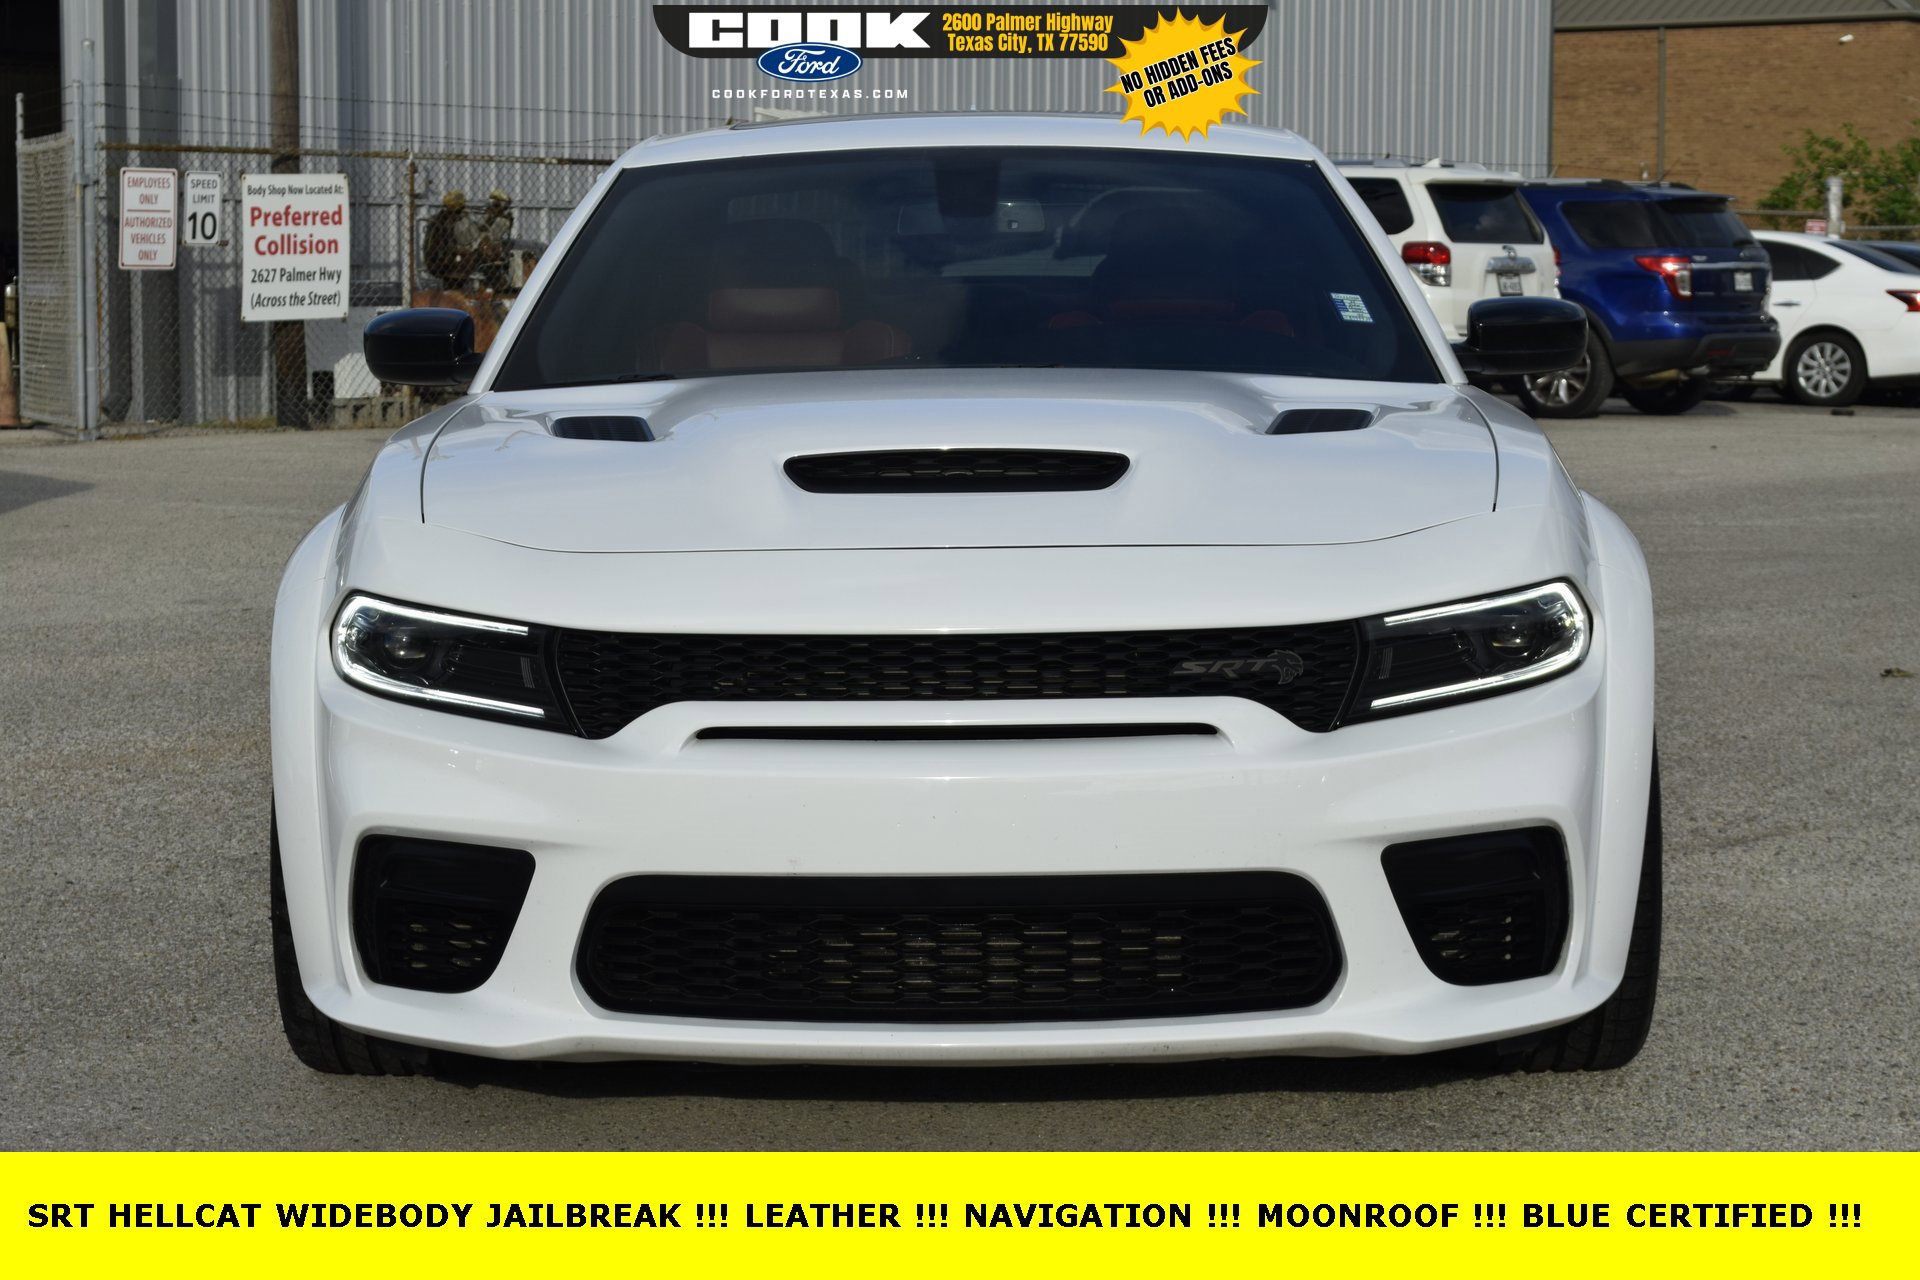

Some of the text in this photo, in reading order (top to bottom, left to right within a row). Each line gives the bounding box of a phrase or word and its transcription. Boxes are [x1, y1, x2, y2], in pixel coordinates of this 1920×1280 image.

[127, 177, 171, 188] EMPLOYEES
[190, 179, 218, 189] SPEED
[247, 184, 344, 197] Body Shop Now Located At:
[139, 193, 159, 205] ONLY
[192, 194, 215, 204] LIMIT
[250, 204, 343, 227] Preferred
[125, 216, 173, 229] AUTHORIZED
[188, 211, 217, 240] 10
[130, 233, 166, 244] VEHICLES
[254, 233, 339, 256] Collision
[138, 249, 158, 261] ONLY
[251, 267, 342, 284] 2627 Palmer Hwy
[250, 290, 341, 310] (Across the Street)
[1172, 658, 1278, 679] SRT
